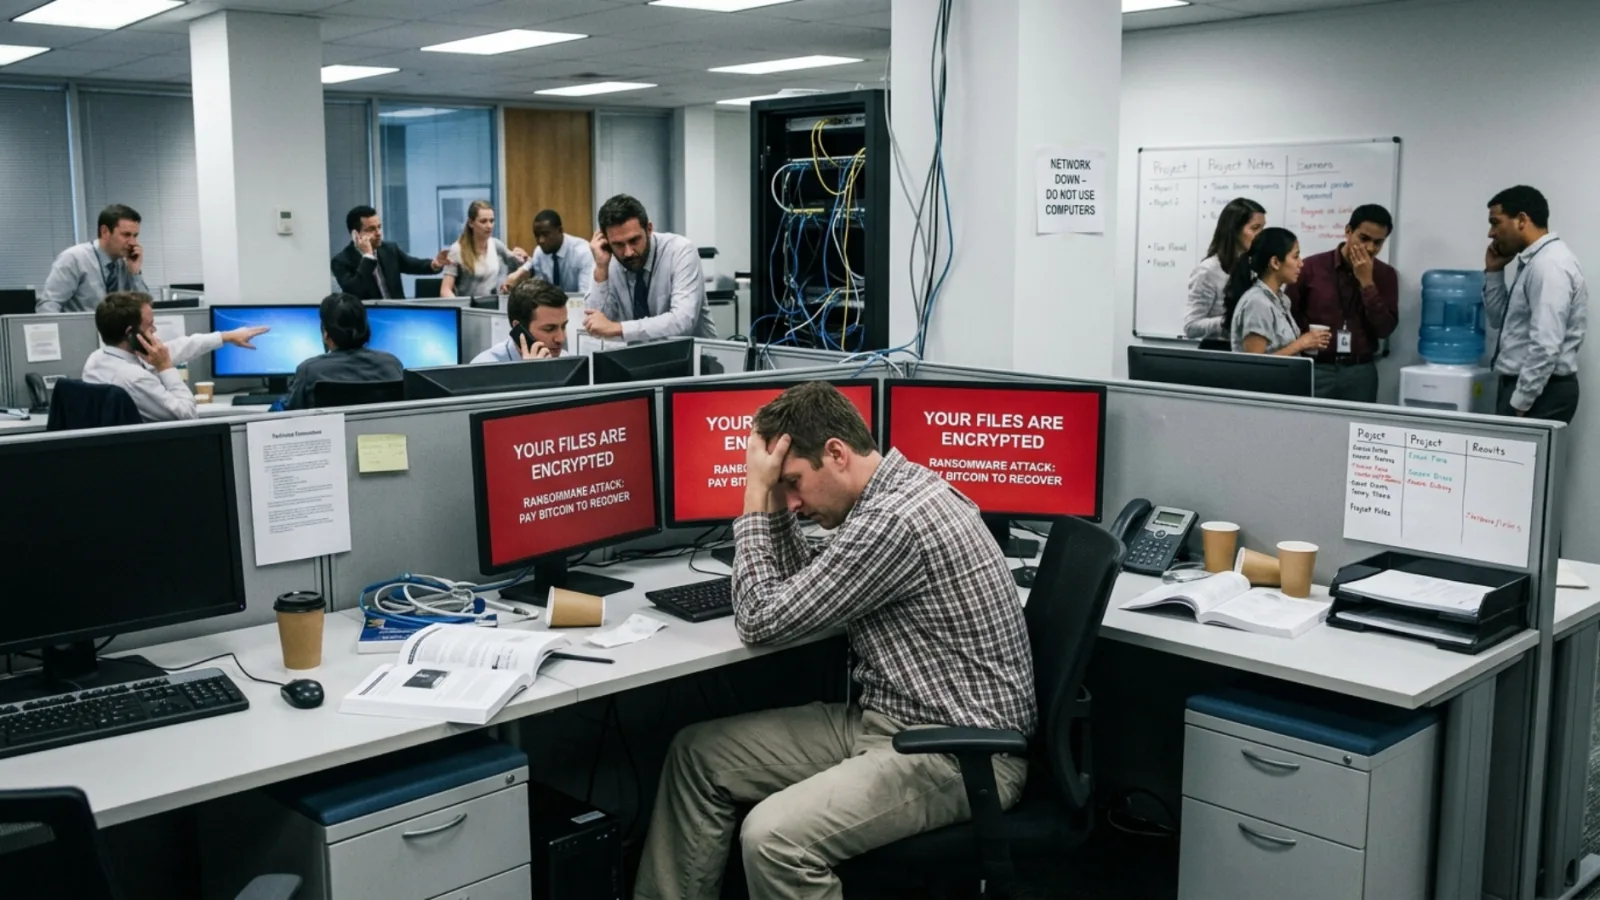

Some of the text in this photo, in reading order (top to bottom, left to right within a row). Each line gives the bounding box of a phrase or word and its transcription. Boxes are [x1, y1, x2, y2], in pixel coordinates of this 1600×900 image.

[1050, 158, 1091, 170] NETWORK
[1247, 158, 1275, 170] Notes
[1054, 174, 1080, 184] DOWN
[1046, 189, 1095, 200] DO NOT USE
[1045, 204, 1096, 215] COMPUTERS
[705, 415, 753, 431] YOUR
[924, 411, 1064, 430] YOUR FILES ARE
[513, 427, 627, 460] YOUR FILES ARE
[941, 431, 1045, 449] ENCRYPTED
[1410, 434, 1442, 448] Project
[531, 451, 614, 480] ENCRYPTED
[929, 457, 1056, 472] RANSOMWARE ATTACK:
[707, 477, 728, 488] PAY
[946, 471, 989, 482] BITCOIN
[991, 473, 1007, 483] TO
[1009, 474, 1062, 486] RECOVER
[589, 478, 625, 496] ATTACK:
[519, 491, 631, 524] PAY BITCOIN TO RECOVER
